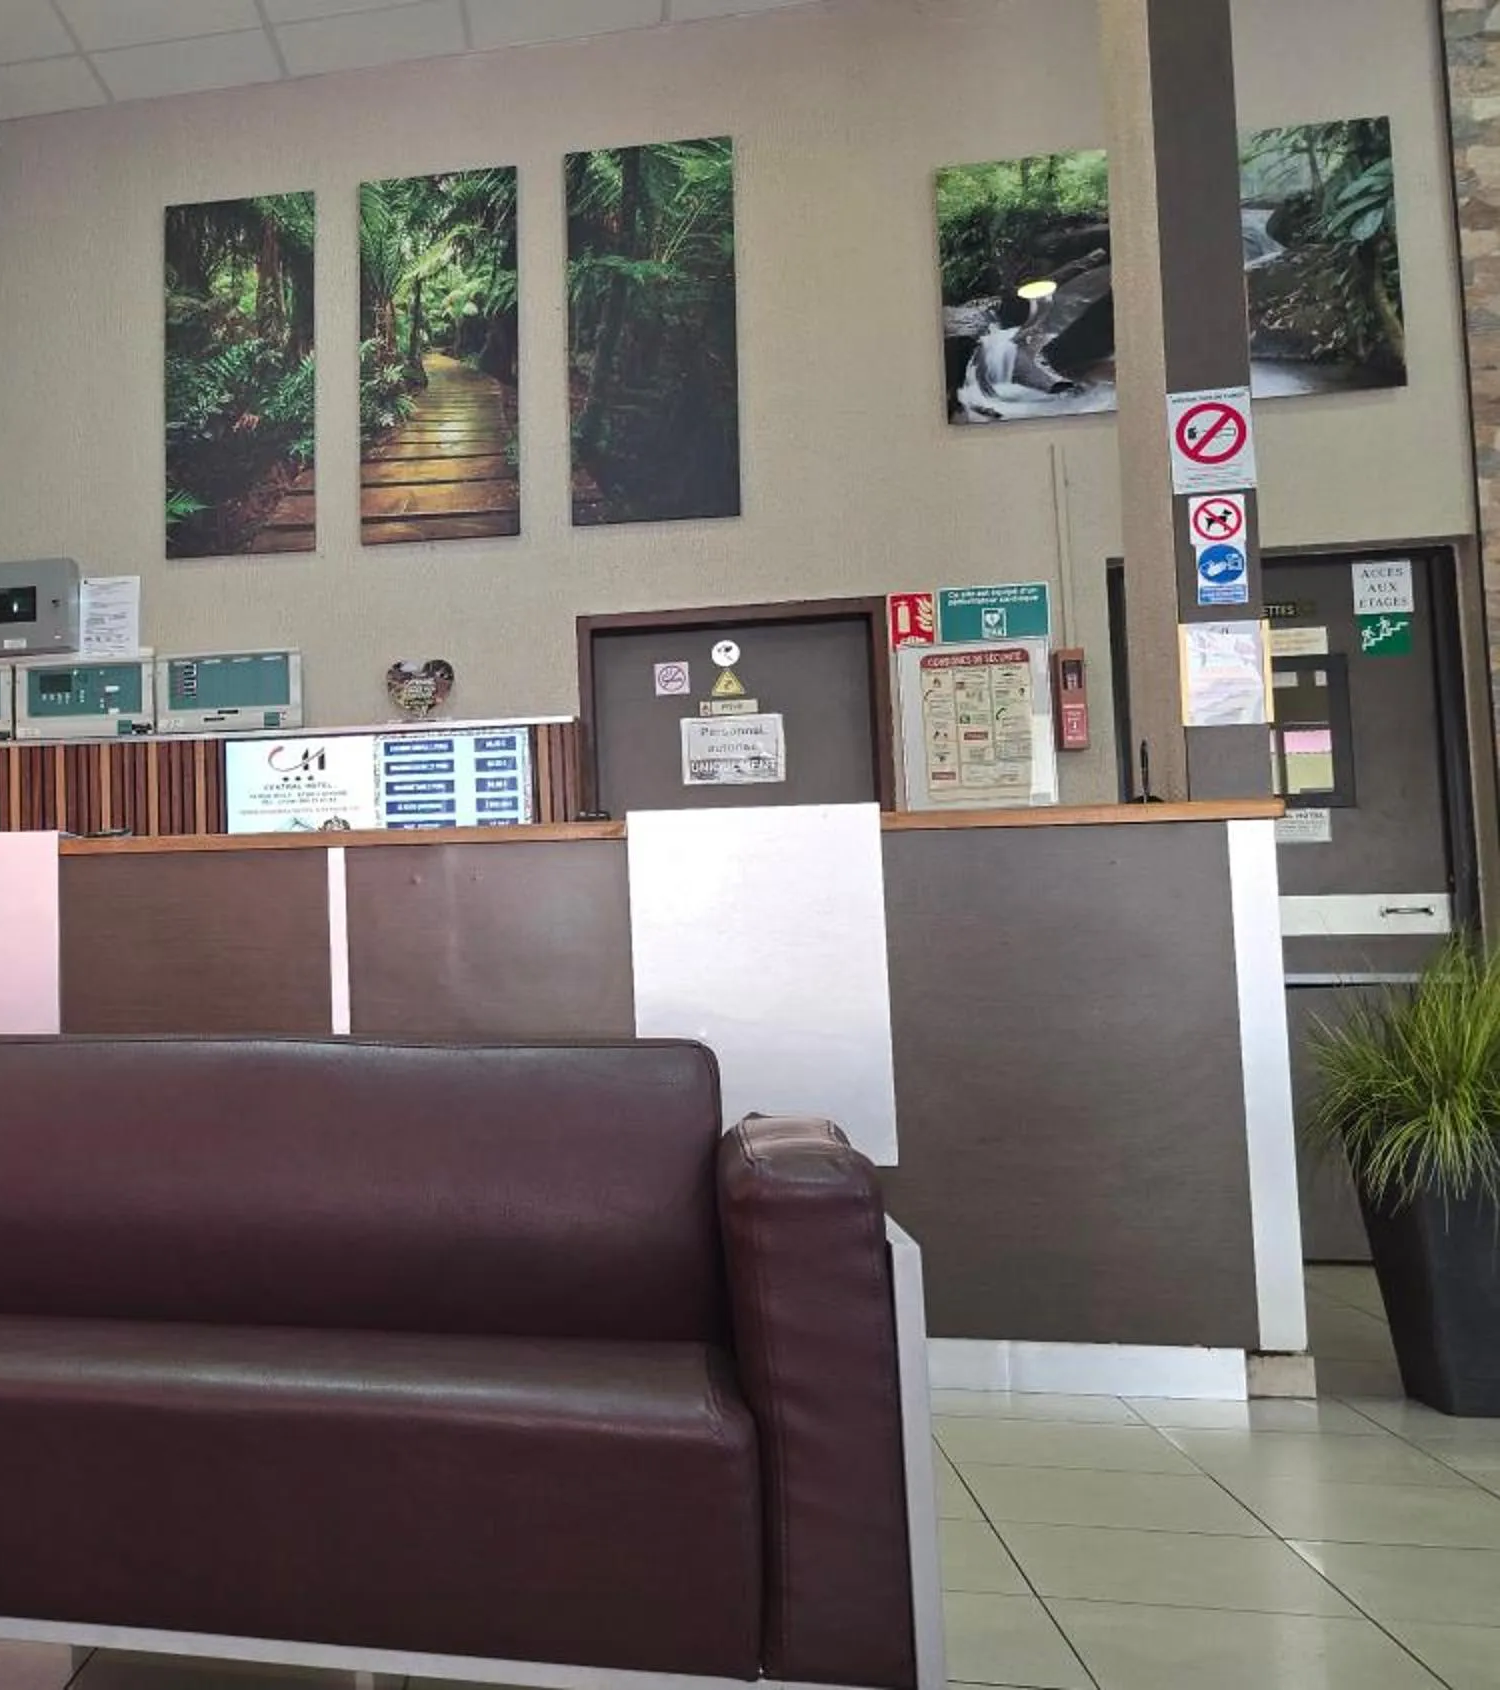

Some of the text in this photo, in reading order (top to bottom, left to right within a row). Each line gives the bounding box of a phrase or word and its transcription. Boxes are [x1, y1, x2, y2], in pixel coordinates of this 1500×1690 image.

[1361, 567, 1404, 579] ACCES
[1367, 582, 1397, 593] AUX
[1359, 596, 1408, 608] ETAGES
